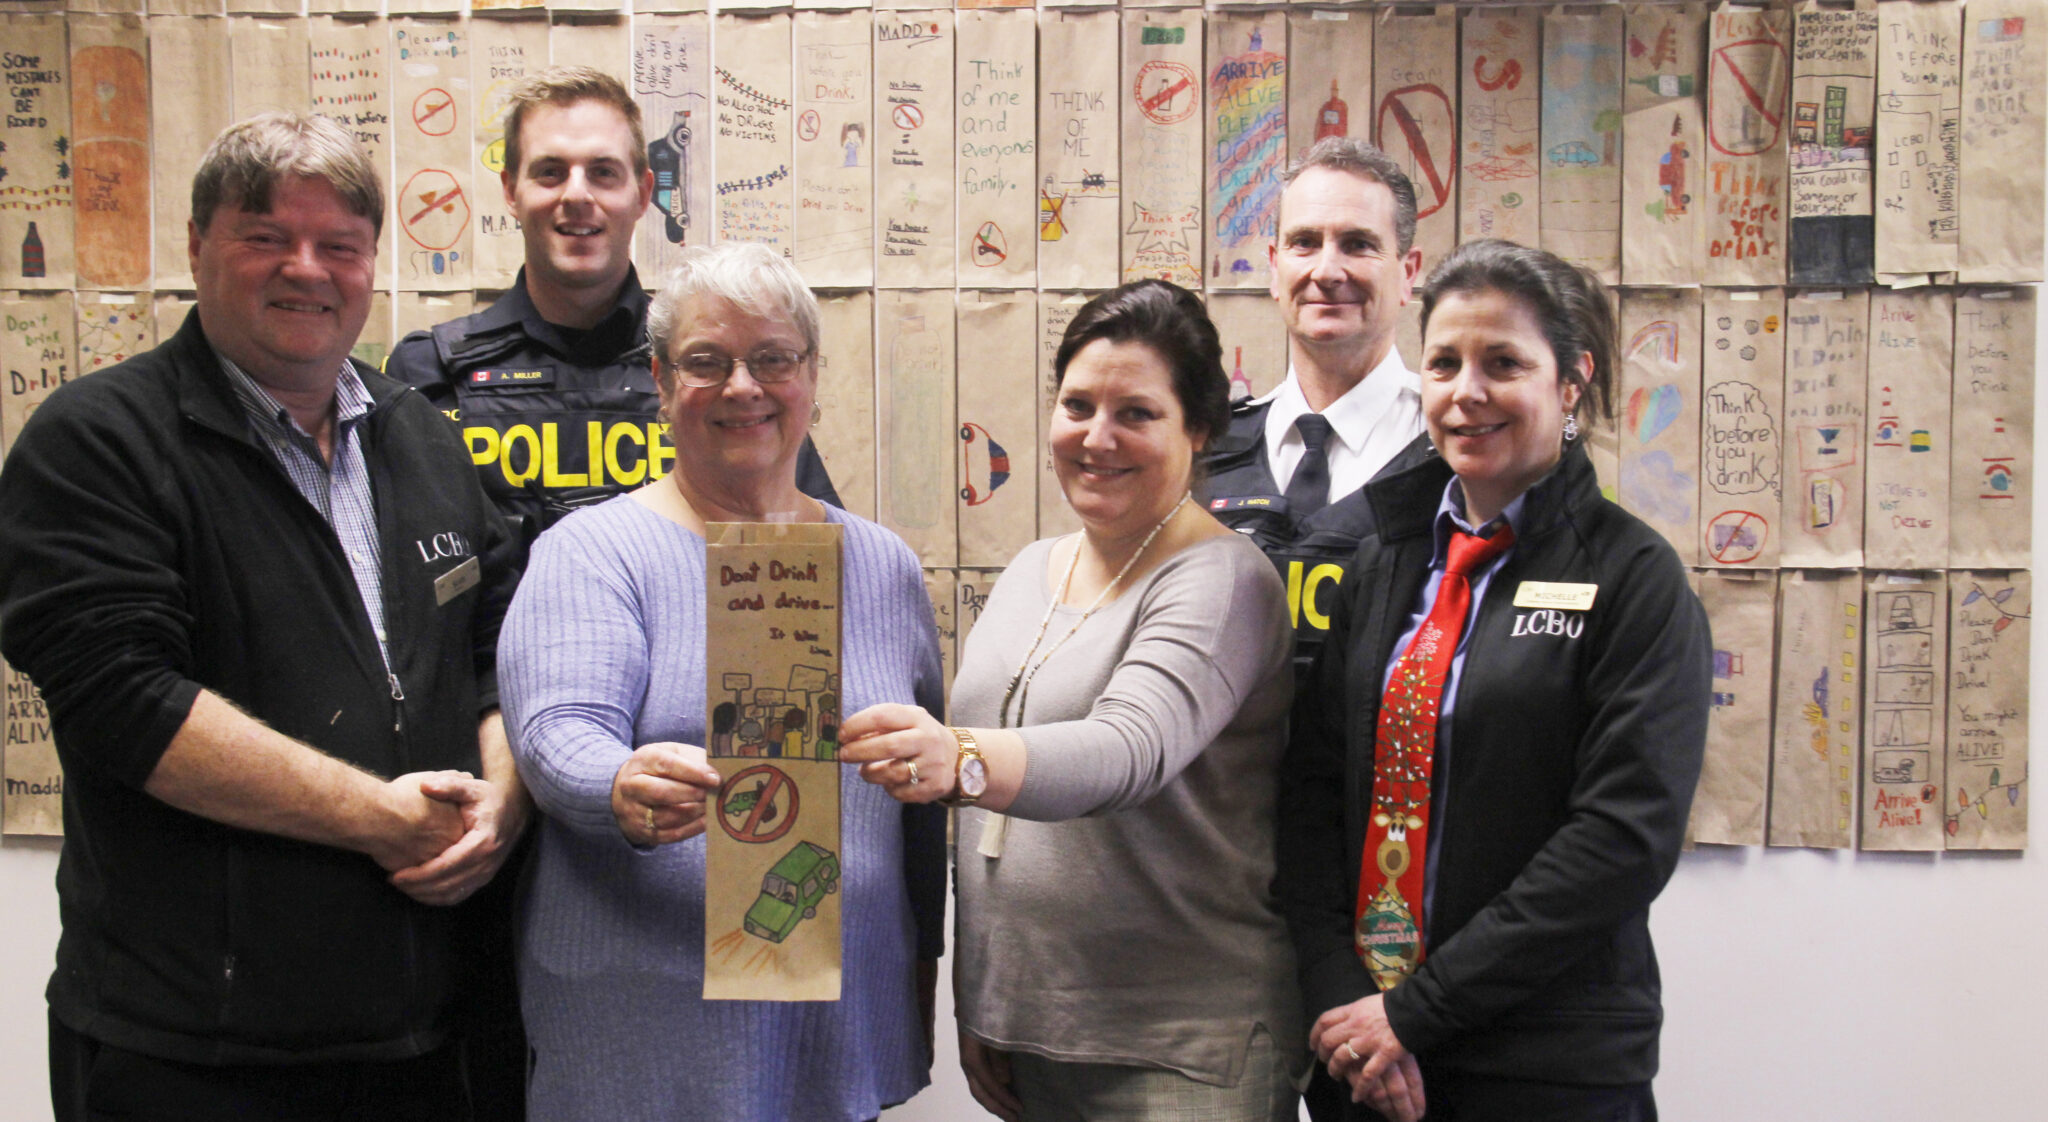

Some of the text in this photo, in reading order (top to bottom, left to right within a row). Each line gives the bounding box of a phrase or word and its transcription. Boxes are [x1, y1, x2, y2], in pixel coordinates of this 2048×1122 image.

[969, 59, 1023, 80] Think
[1215, 61, 1285, 81] ARRIVE
[15, 98, 33, 112] BE
[962, 84, 1020, 106] of me
[1050, 91, 1104, 111] THINK
[1214, 85, 1281, 111] ALIVE
[962, 110, 1007, 134] and
[1067, 118, 1088, 137] OF
[1217, 112, 1286, 133] PLEASE
[1064, 138, 1090, 157] ME
[1894, 134, 1924, 148] LCBO
[1140, 211, 1174, 223] Think
[513, 371, 542, 379] MILLER
[1713, 415, 1770, 444] before
[463, 421, 676, 487] POLICE
[1716, 446, 1746, 471] you
[416, 531, 471, 563] LCBO
[727, 594, 765, 611] and
[1510, 609, 1585, 639] LCBO
[1957, 704, 1979, 722] You
[1874, 787, 1918, 811] Arrive
[1360, 931, 1420, 946] CHRISTMAS
